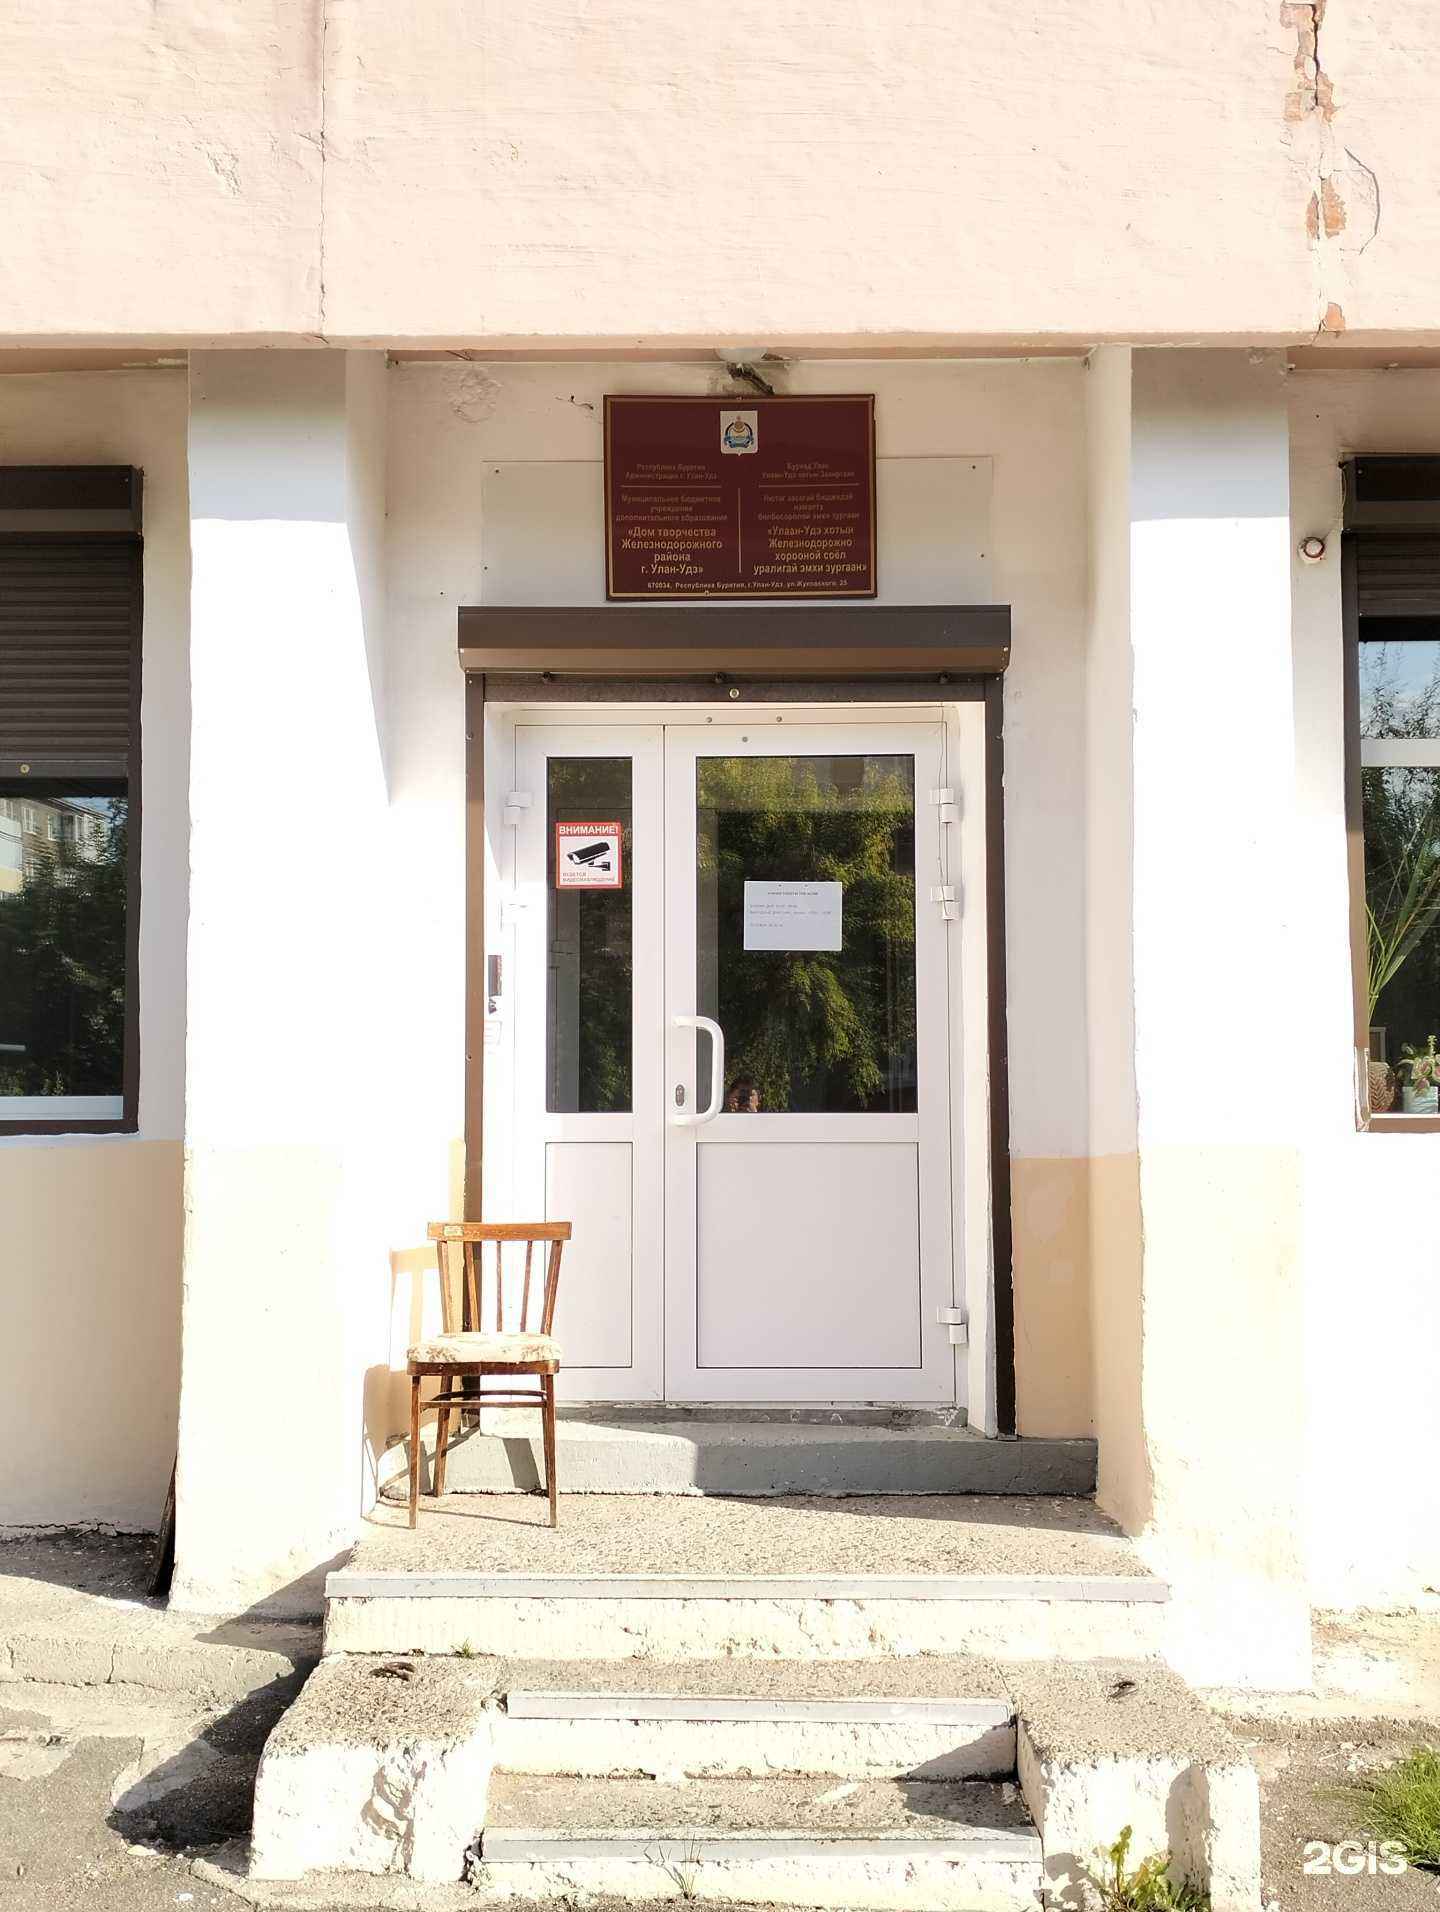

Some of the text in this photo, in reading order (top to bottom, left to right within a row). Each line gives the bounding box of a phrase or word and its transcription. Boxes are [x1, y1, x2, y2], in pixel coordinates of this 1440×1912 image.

[628, 526, 717, 538] «Дом творчества
[768, 526, 854, 537] «Улаан-Удэ хотын
[621, 539, 723, 551] Железнодорожного
[769, 538, 853, 549] Железнодорожно
[654, 551, 691, 562] района
[641, 563, 704, 575] г. Улан-Удэ»
[753, 563, 867, 575] уралигай эмхи зургаан»
[675, 582, 714, 590] Республика
[559, 825, 618, 834] ВНИМАНИЕ!
